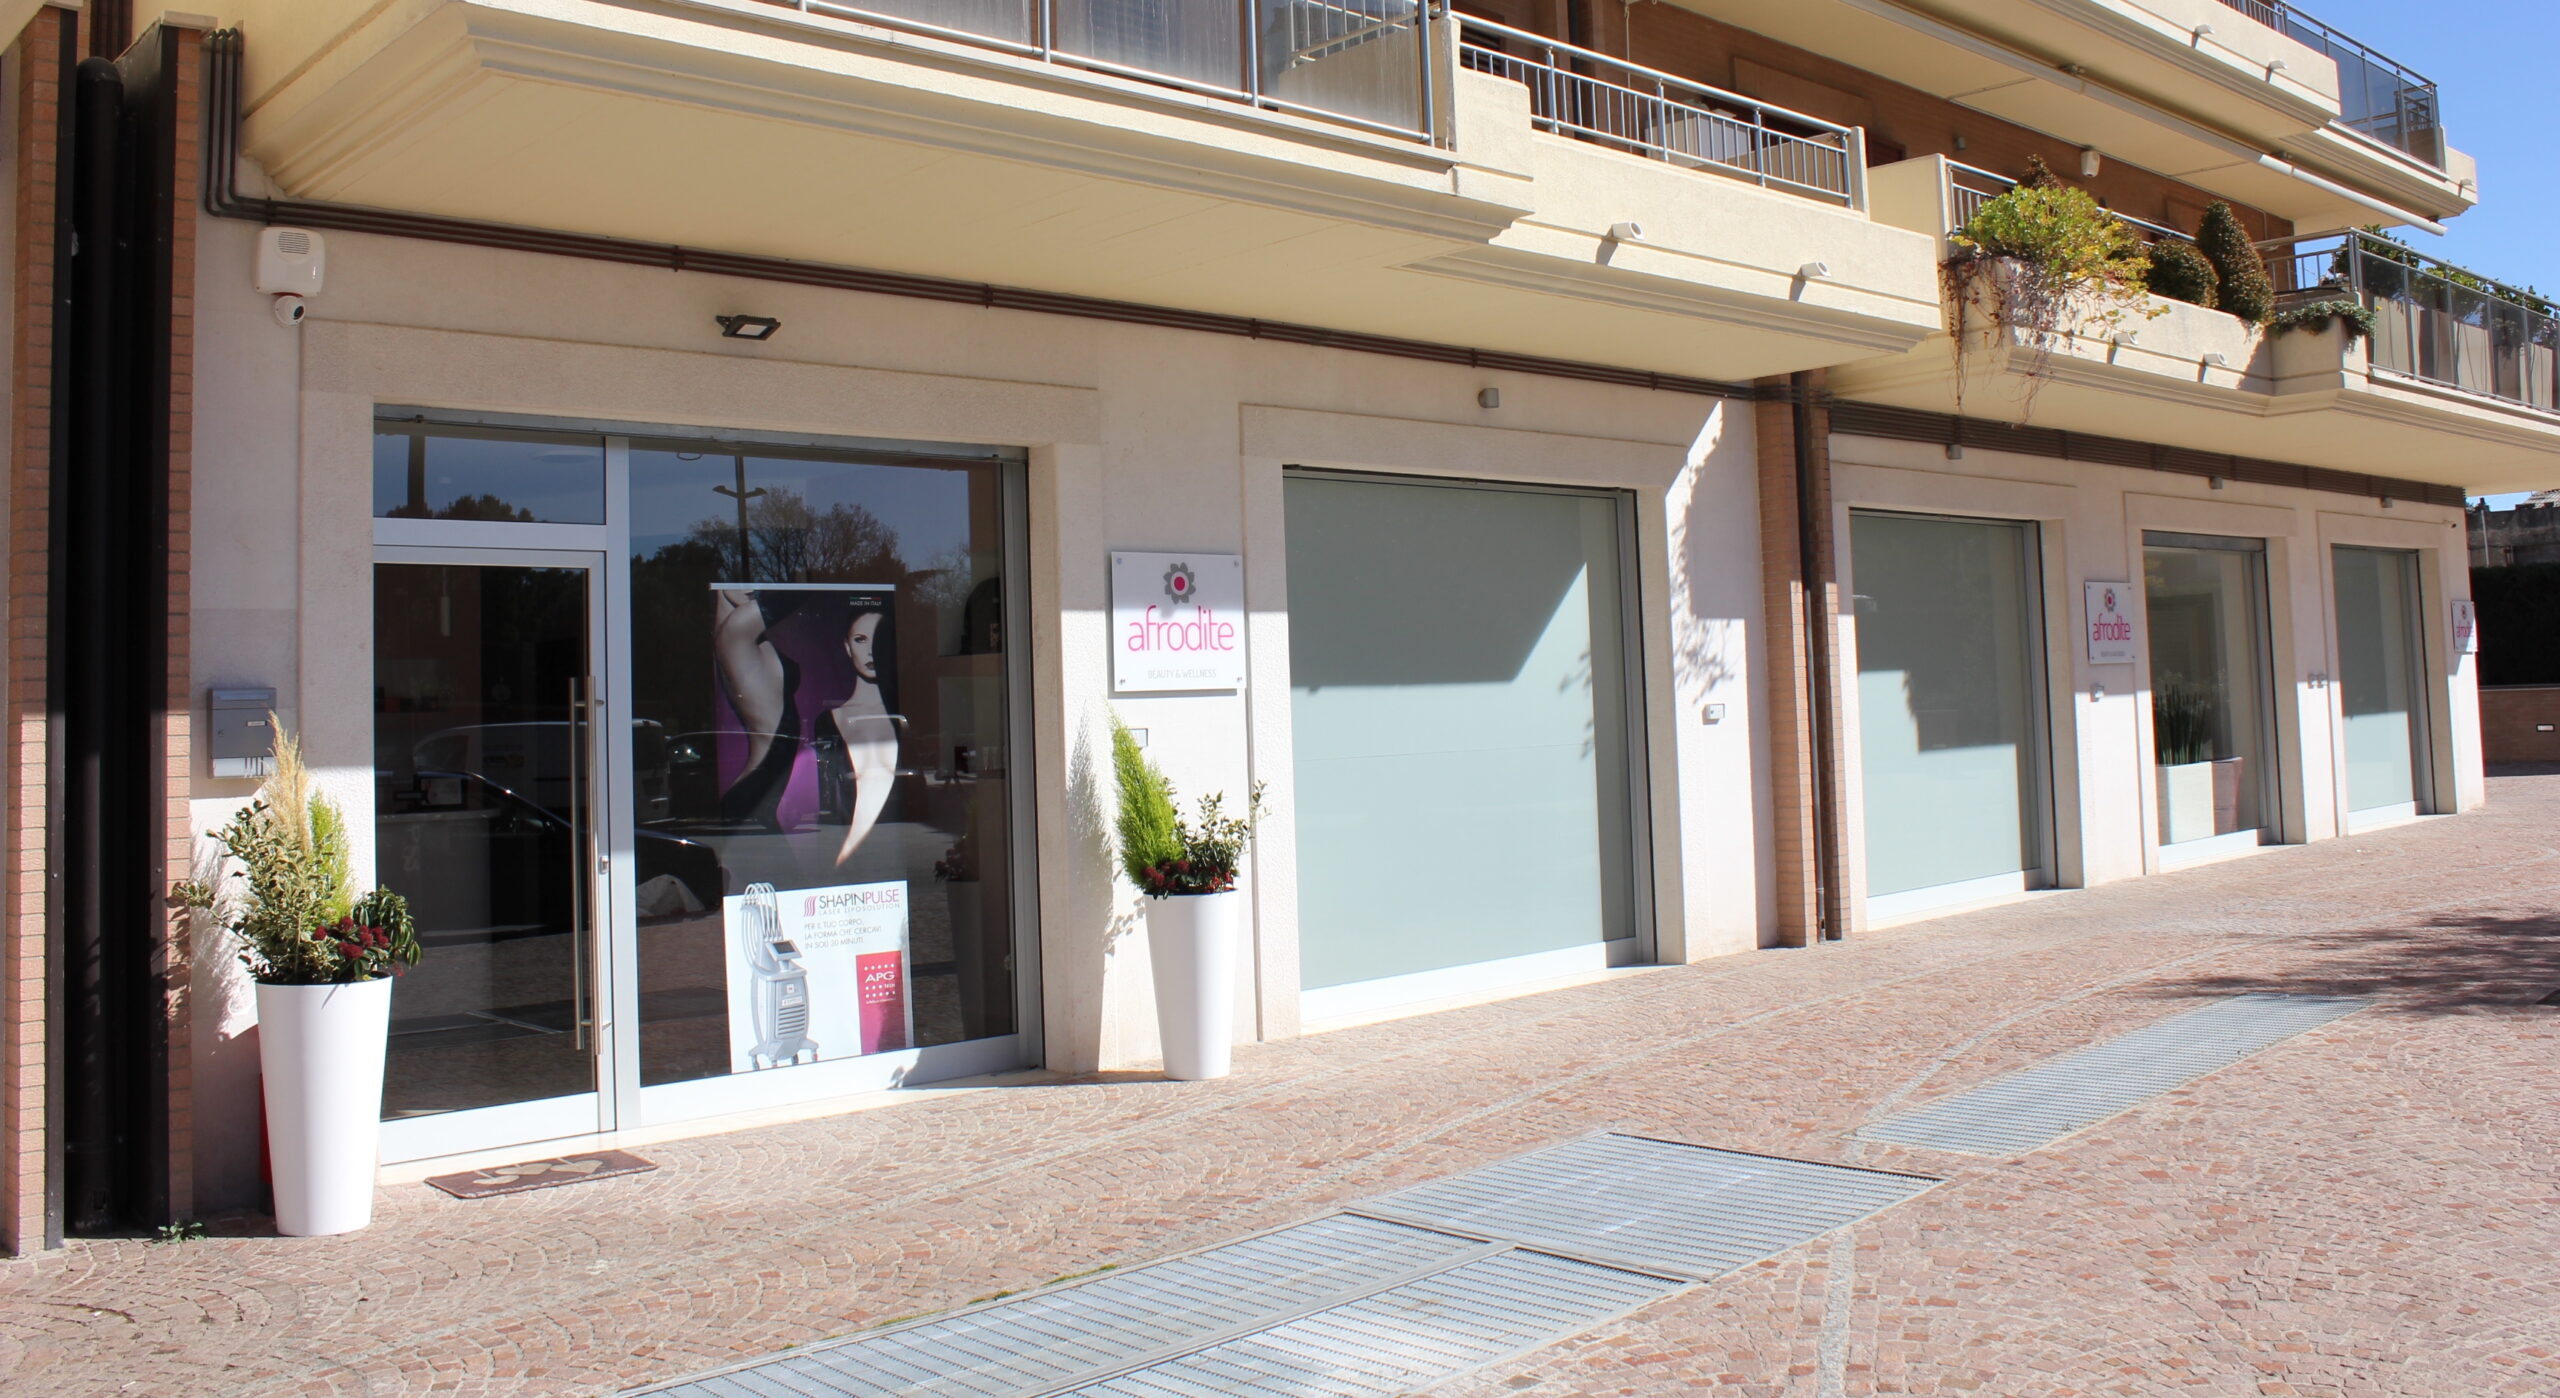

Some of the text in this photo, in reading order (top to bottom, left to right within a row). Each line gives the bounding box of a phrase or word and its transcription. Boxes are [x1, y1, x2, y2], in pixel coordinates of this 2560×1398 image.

[1128, 605, 1234, 651] afrodite
[2093, 613, 2131, 640] afrodite
[1147, 668, 1217, 679] BEAUTY & WELLNESS
[819, 889, 899, 909] SHAPINPULSE
[845, 903, 900, 913] LIPOSOLUTION
[823, 920, 837, 928] TUO
[865, 971, 896, 983] APG
